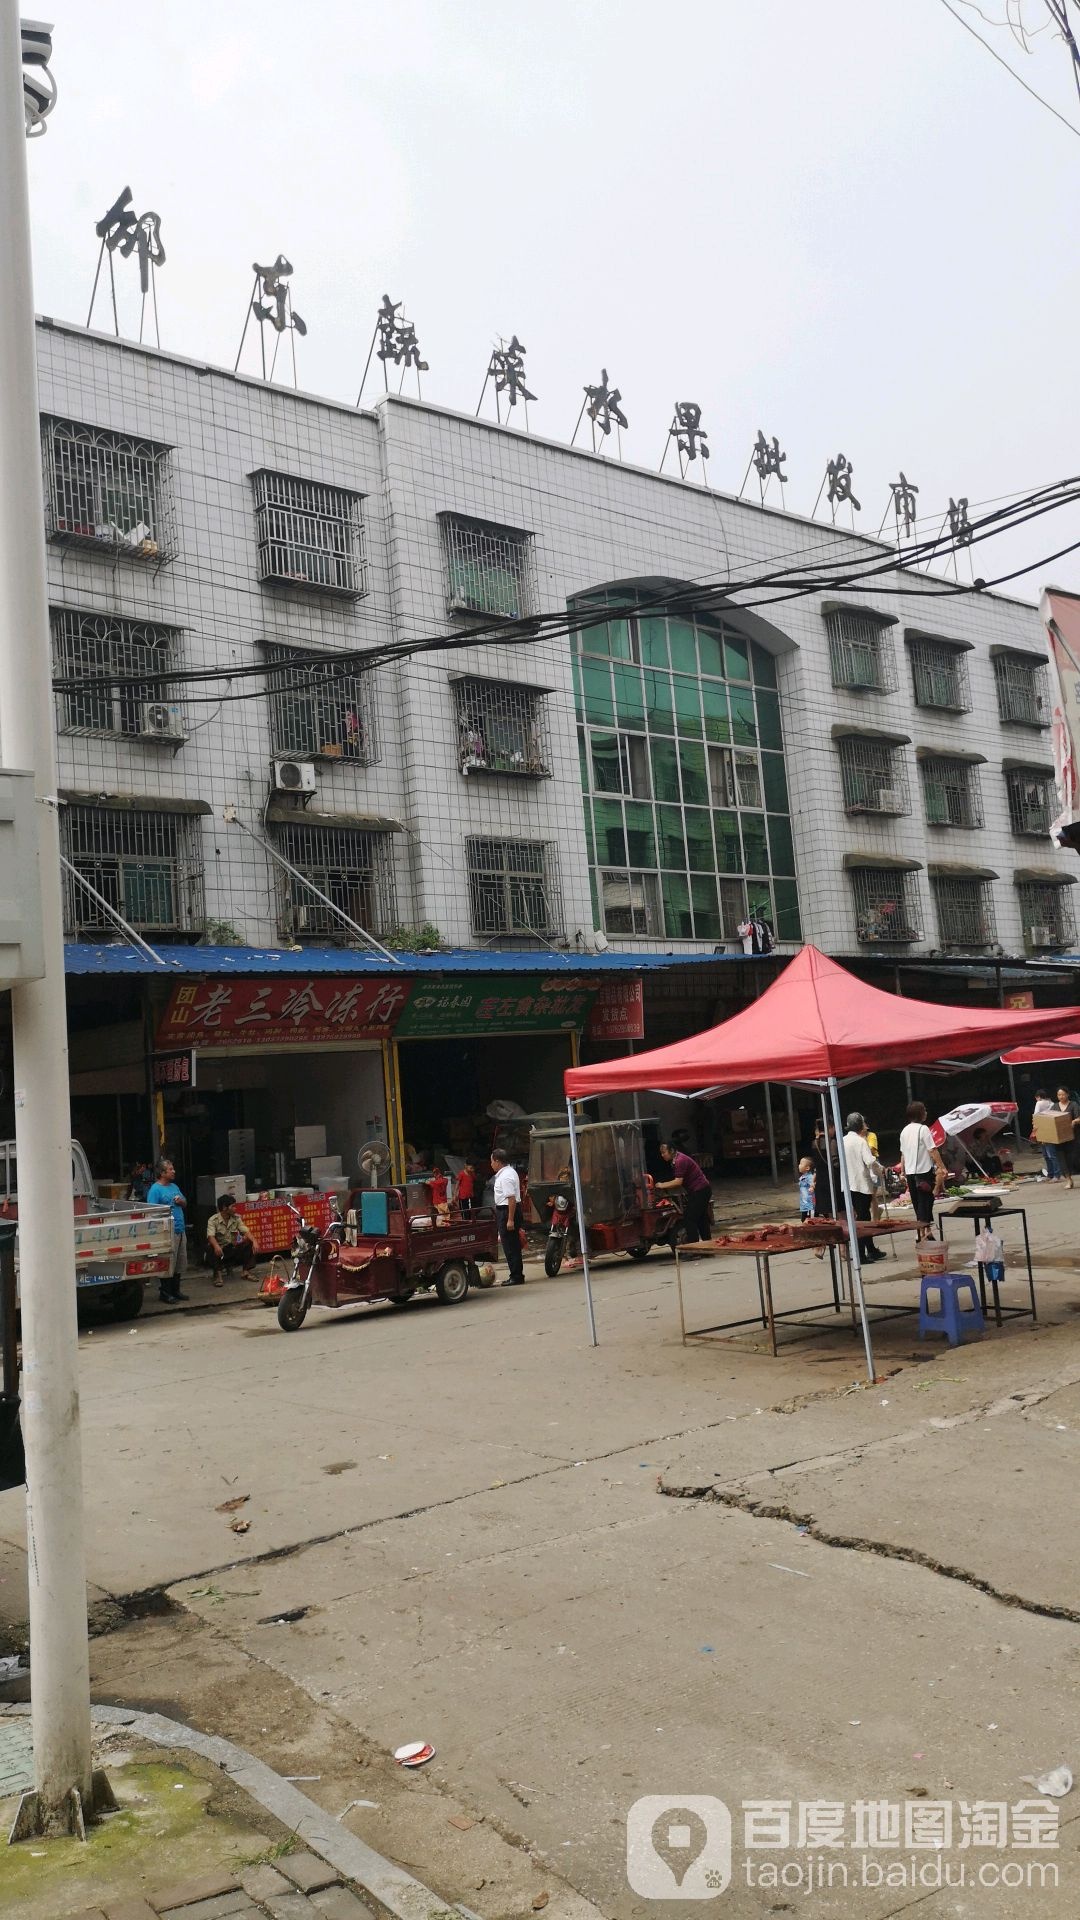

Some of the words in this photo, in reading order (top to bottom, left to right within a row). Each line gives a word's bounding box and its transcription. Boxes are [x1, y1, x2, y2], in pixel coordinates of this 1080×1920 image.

[170, 985, 198, 1024] 团山
[187, 981, 405, 1026] 老三冷冻行
